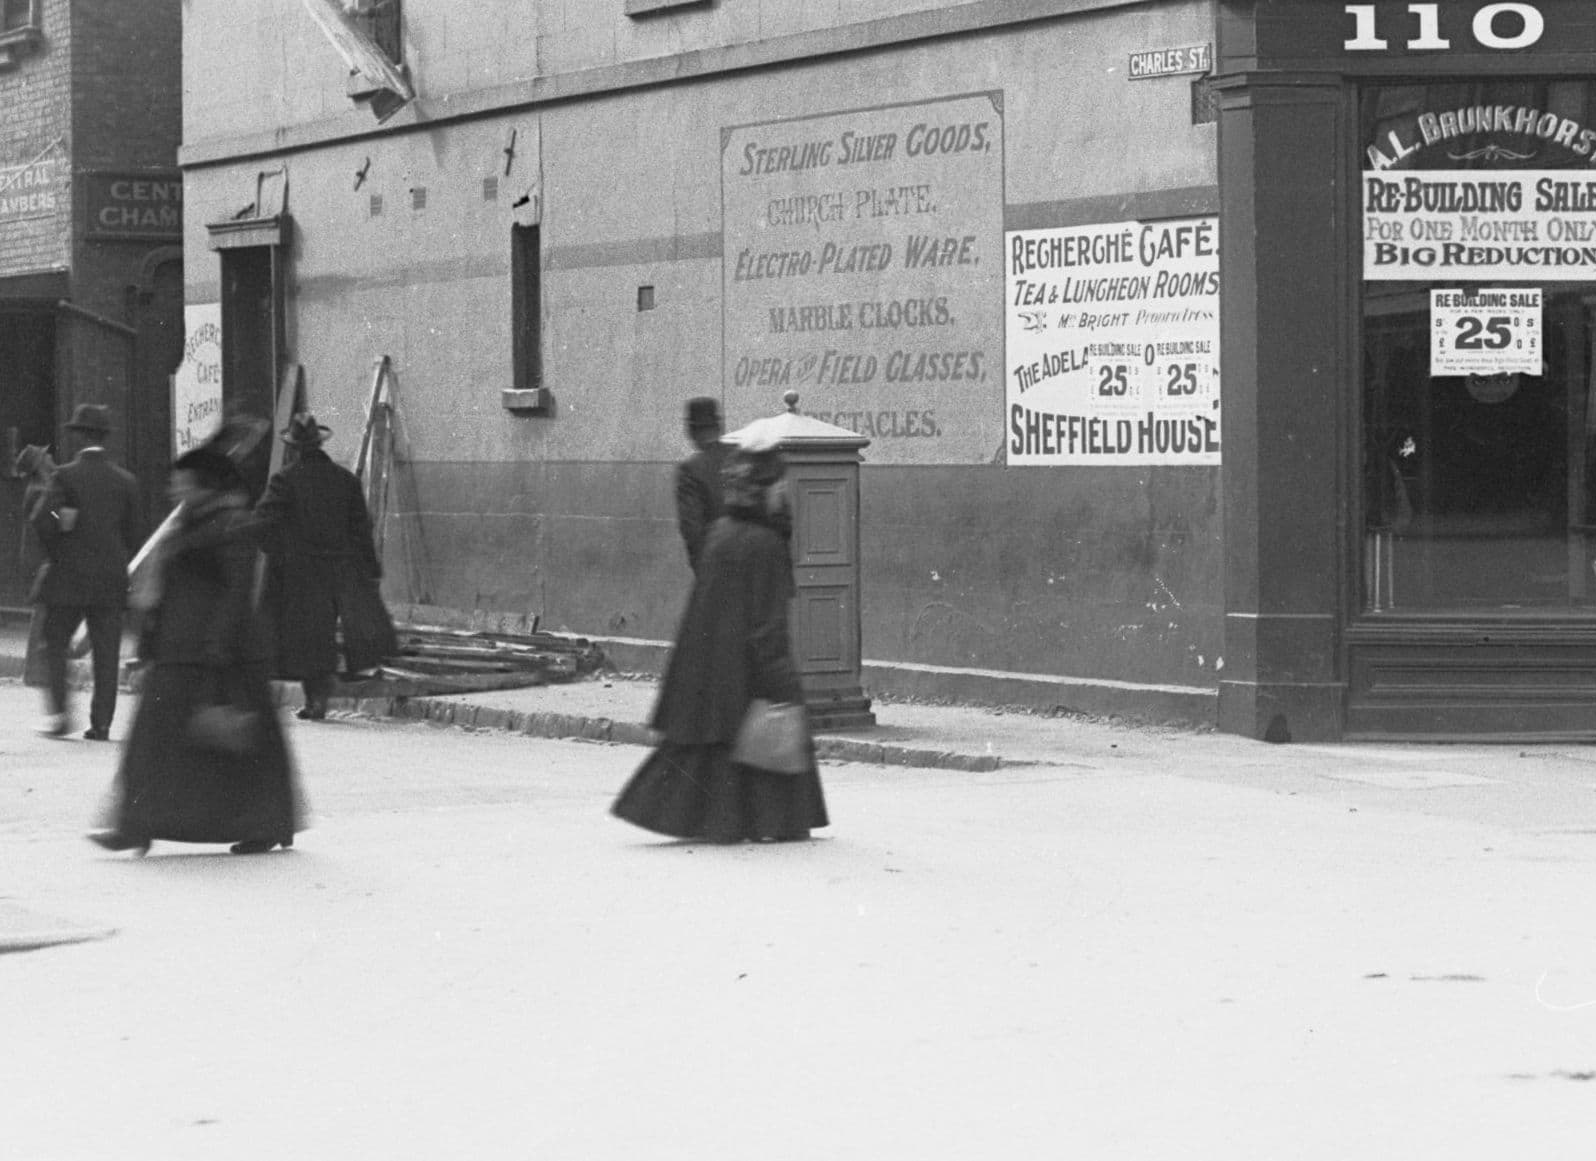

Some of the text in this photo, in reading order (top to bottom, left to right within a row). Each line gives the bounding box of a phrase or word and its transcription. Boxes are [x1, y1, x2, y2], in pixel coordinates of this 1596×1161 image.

[1341, 1, 1547, 52] 110
[1130, 50, 1183, 76] CHARLES
[739, 140, 834, 177] STERLING
[837, 131, 898, 166] SILVER
[110, 181, 184, 201] CENT
[1366, 176, 1523, 214] RE-BUILDING
[100, 206, 179, 227] CHAM
[766, 192, 845, 232] CHURCH
[1366, 216, 1404, 242] FOR
[1409, 216, 1453, 242] ONE
[1459, 215, 1539, 242] MONTH
[1373, 242, 1438, 267] BIG
[1014, 279, 1047, 307] TEA
[1048, 284, 1059, 305] &
[1152, 270, 1220, 299] ROOMS
[1509, 293, 1540, 308] SALE
[769, 303, 854, 334] MARBLE
[1078, 312, 1131, 331] BRIGHT
[1454, 315, 1512, 350] 25
[1126, 343, 1142, 357] SALE
[1195, 340, 1212, 354] SALE
[733, 355, 795, 388] OPERA
[816, 348, 879, 385] FIELD
[1013, 361, 1042, 394] THE
[1098, 364, 1128, 397] 25
[1167, 363, 1198, 397] 25
[1011, 403, 1220, 456] SHEFFIELD HOUSE
